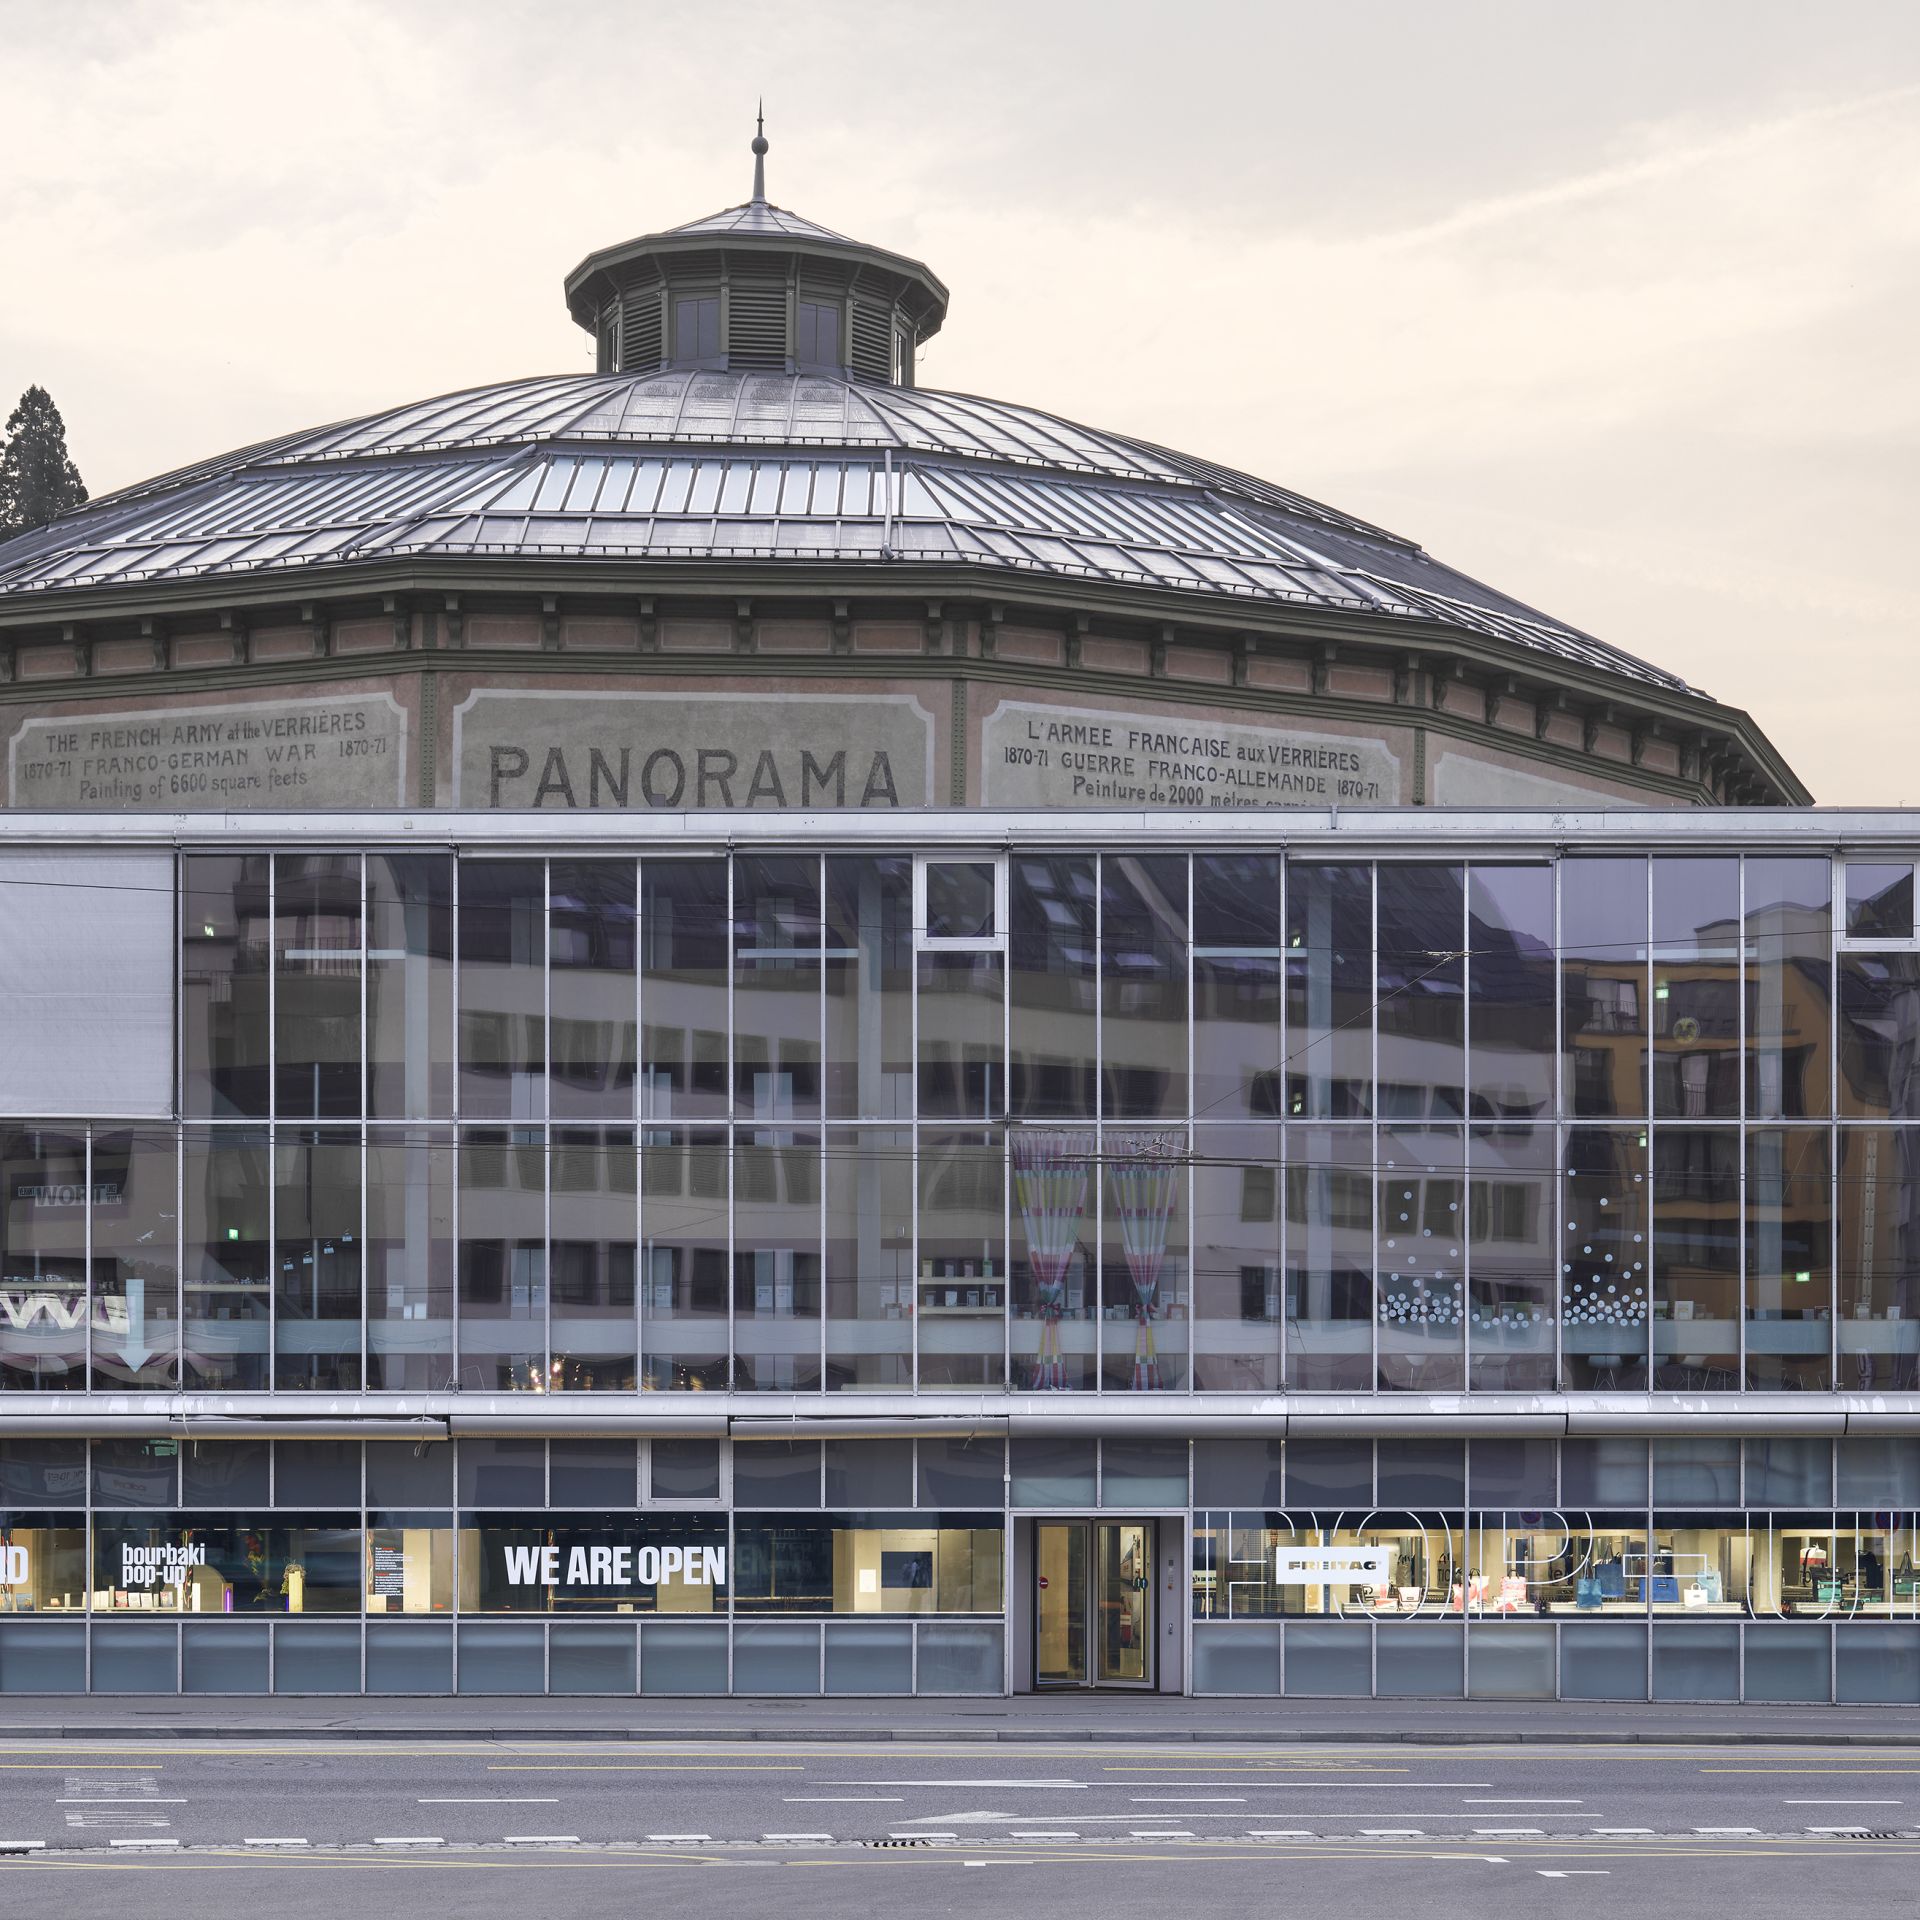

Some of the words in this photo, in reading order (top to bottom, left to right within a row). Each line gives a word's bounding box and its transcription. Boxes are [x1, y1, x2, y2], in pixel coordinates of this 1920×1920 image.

[46, 734, 79, 752] THE
[91, 727, 161, 750] FRENCH
[172, 723, 222, 744] ARMY
[227, 723, 239, 740] at
[243, 721, 260, 739] the
[1028, 720, 1113, 748] L'ARMEE
[1237, 746, 1264, 763] aux
[24, 760, 71, 779] 1870-71
[83, 748, 249, 776] FRANCO-GERMAN
[265, 743, 317, 763] WAR
[339, 737, 386, 757] 1870-71
[1004, 746, 1048, 767] 1870-71
[1061, 752, 1135, 776] GUERRE
[1148, 759, 1326, 794] FRANCO-ALLEMANDE
[1337, 779, 1379, 799] 1870-71
[80, 777, 142, 801] Painting
[150, 775, 165, 798] of
[170, 773, 207, 794] 6600
[211, 774, 261, 796] square
[269, 767, 308, 792] feets
[489, 746, 898, 807] PANORAMA
[1073, 775, 1146, 801] Peinture
[1150, 783, 1166, 802] de
[1169, 784, 1204, 806] 2000
[122, 1542, 205, 1565] bourbaki
[503, 1546, 560, 1585] WE
[566, 1546, 631, 1585] ARE
[638, 1546, 726, 1585] OPEN
[1288, 1560, 1377, 1571] FREITAG
[122, 1566, 187, 1589] pop-up
